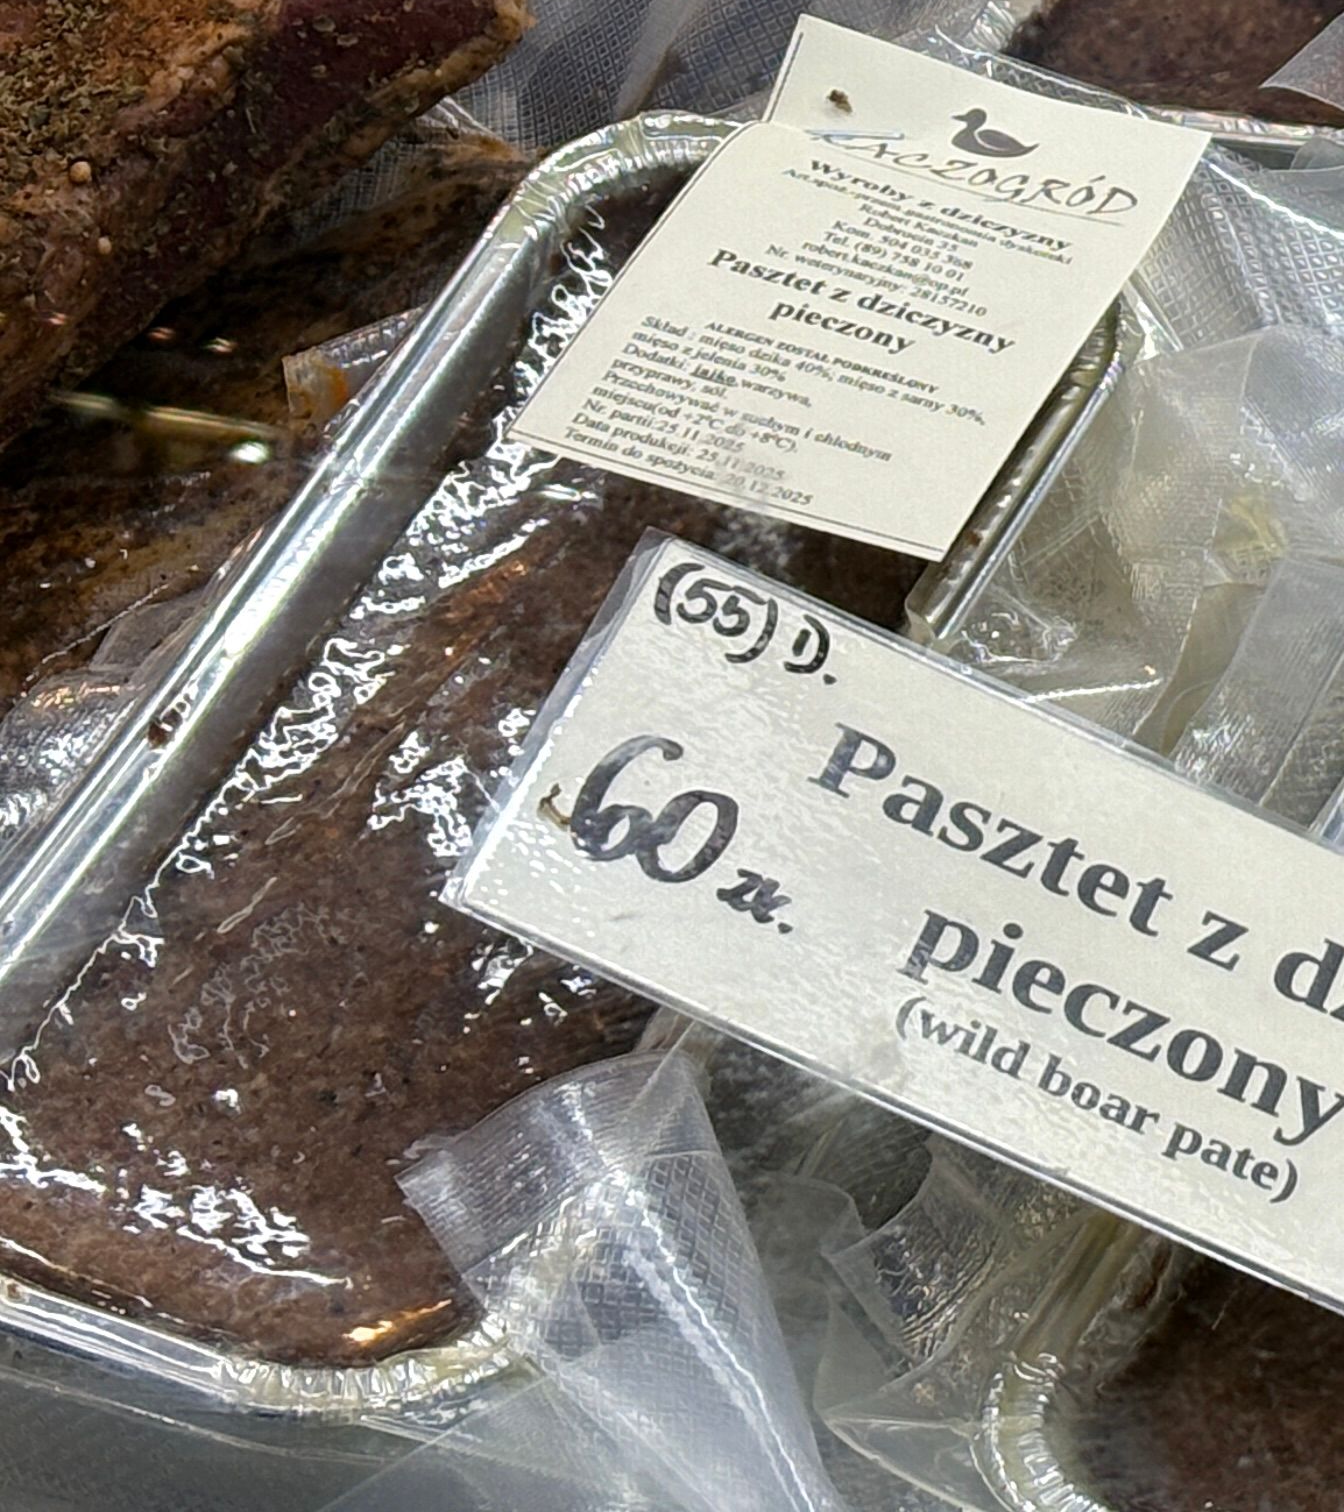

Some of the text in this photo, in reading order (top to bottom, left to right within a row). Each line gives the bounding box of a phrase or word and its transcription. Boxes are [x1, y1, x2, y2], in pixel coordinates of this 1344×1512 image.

[811, 159, 1072, 252] Wyroby z dziczyzny
[858, 203, 912, 227] Robert
[823, 231, 965, 282] Tel. (89) 758 10 01
[879, 235, 909, 250] 504
[910, 244, 941, 260] 035
[937, 240, 959, 252] 35
[707, 248, 1016, 355] Pasztet z dziczyzny
[765, 244, 789, 259] Nr.
[909, 286, 988, 317] 28157210
[640, 315, 690, 338] Skład
[767, 302, 916, 355] pieczony
[571, 412, 611, 433] Data
[581, 397, 607, 415] Nr.
[564, 426, 620, 453] Termin
[654, 562, 779, 664] (55)
[570, 734, 739, 883] 60
[808, 723, 1173, 936] Pasztet
[1187, 911, 1248, 971] z
[896, 997, 1297, 1203] (wild boar pate)
